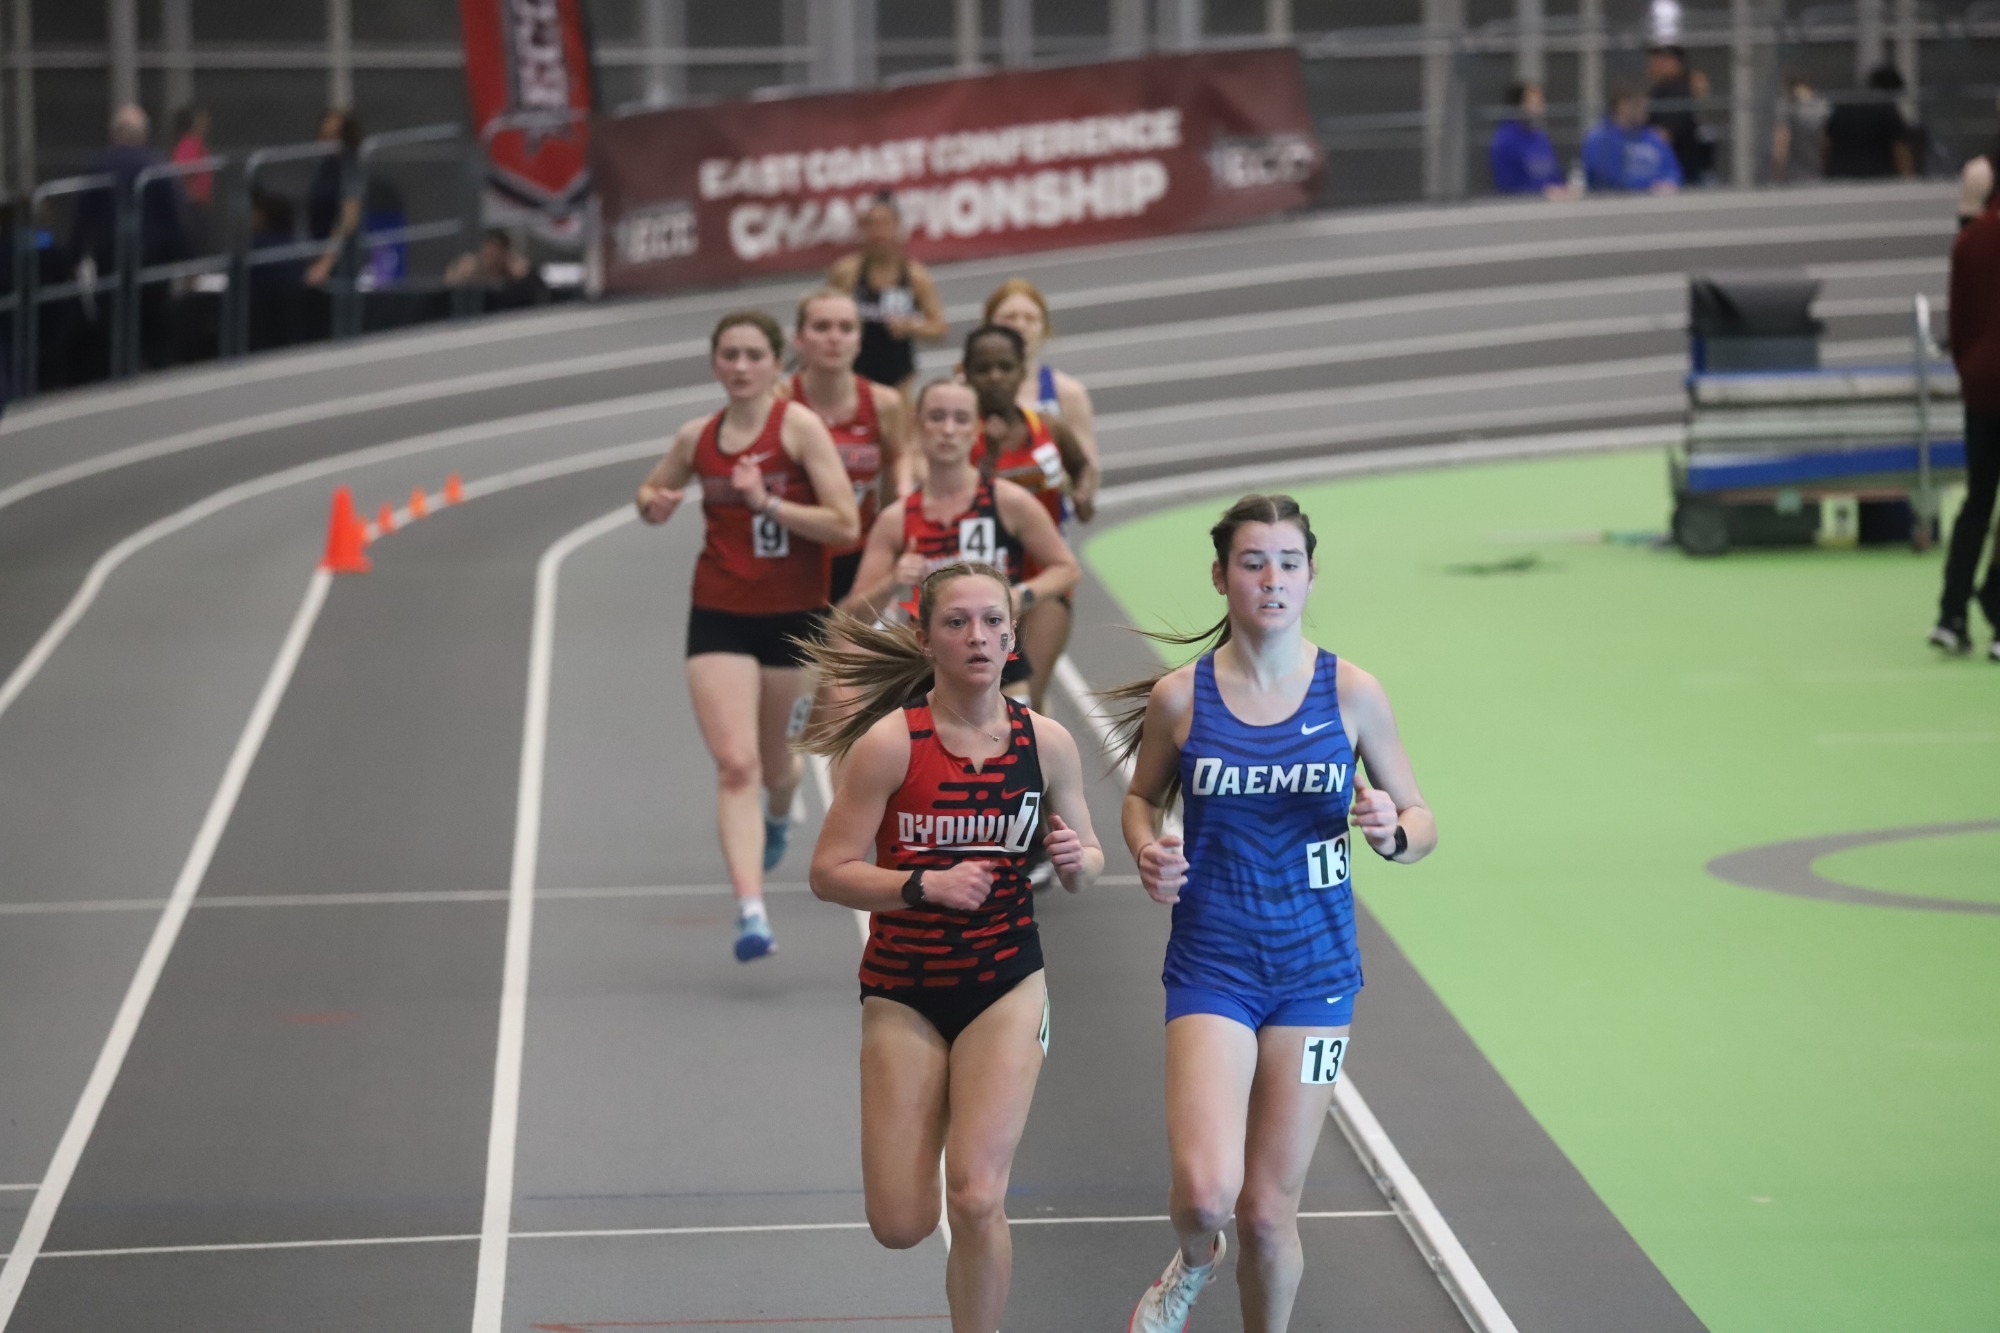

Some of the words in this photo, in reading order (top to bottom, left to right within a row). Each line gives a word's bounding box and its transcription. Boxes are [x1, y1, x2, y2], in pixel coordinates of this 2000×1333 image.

[701, 153, 799, 198] EAST
[804, 138, 928, 191] COAST
[931, 107, 1182, 174] CONFERENCE
[760, 516, 782, 551] 9
[966, 523, 987, 557] 4
[1192, 757, 1347, 796] DAEMEN
[1014, 796, 1038, 847] 7
[1311, 837, 1348, 886] 13
[1308, 1039, 1343, 1082] 13
